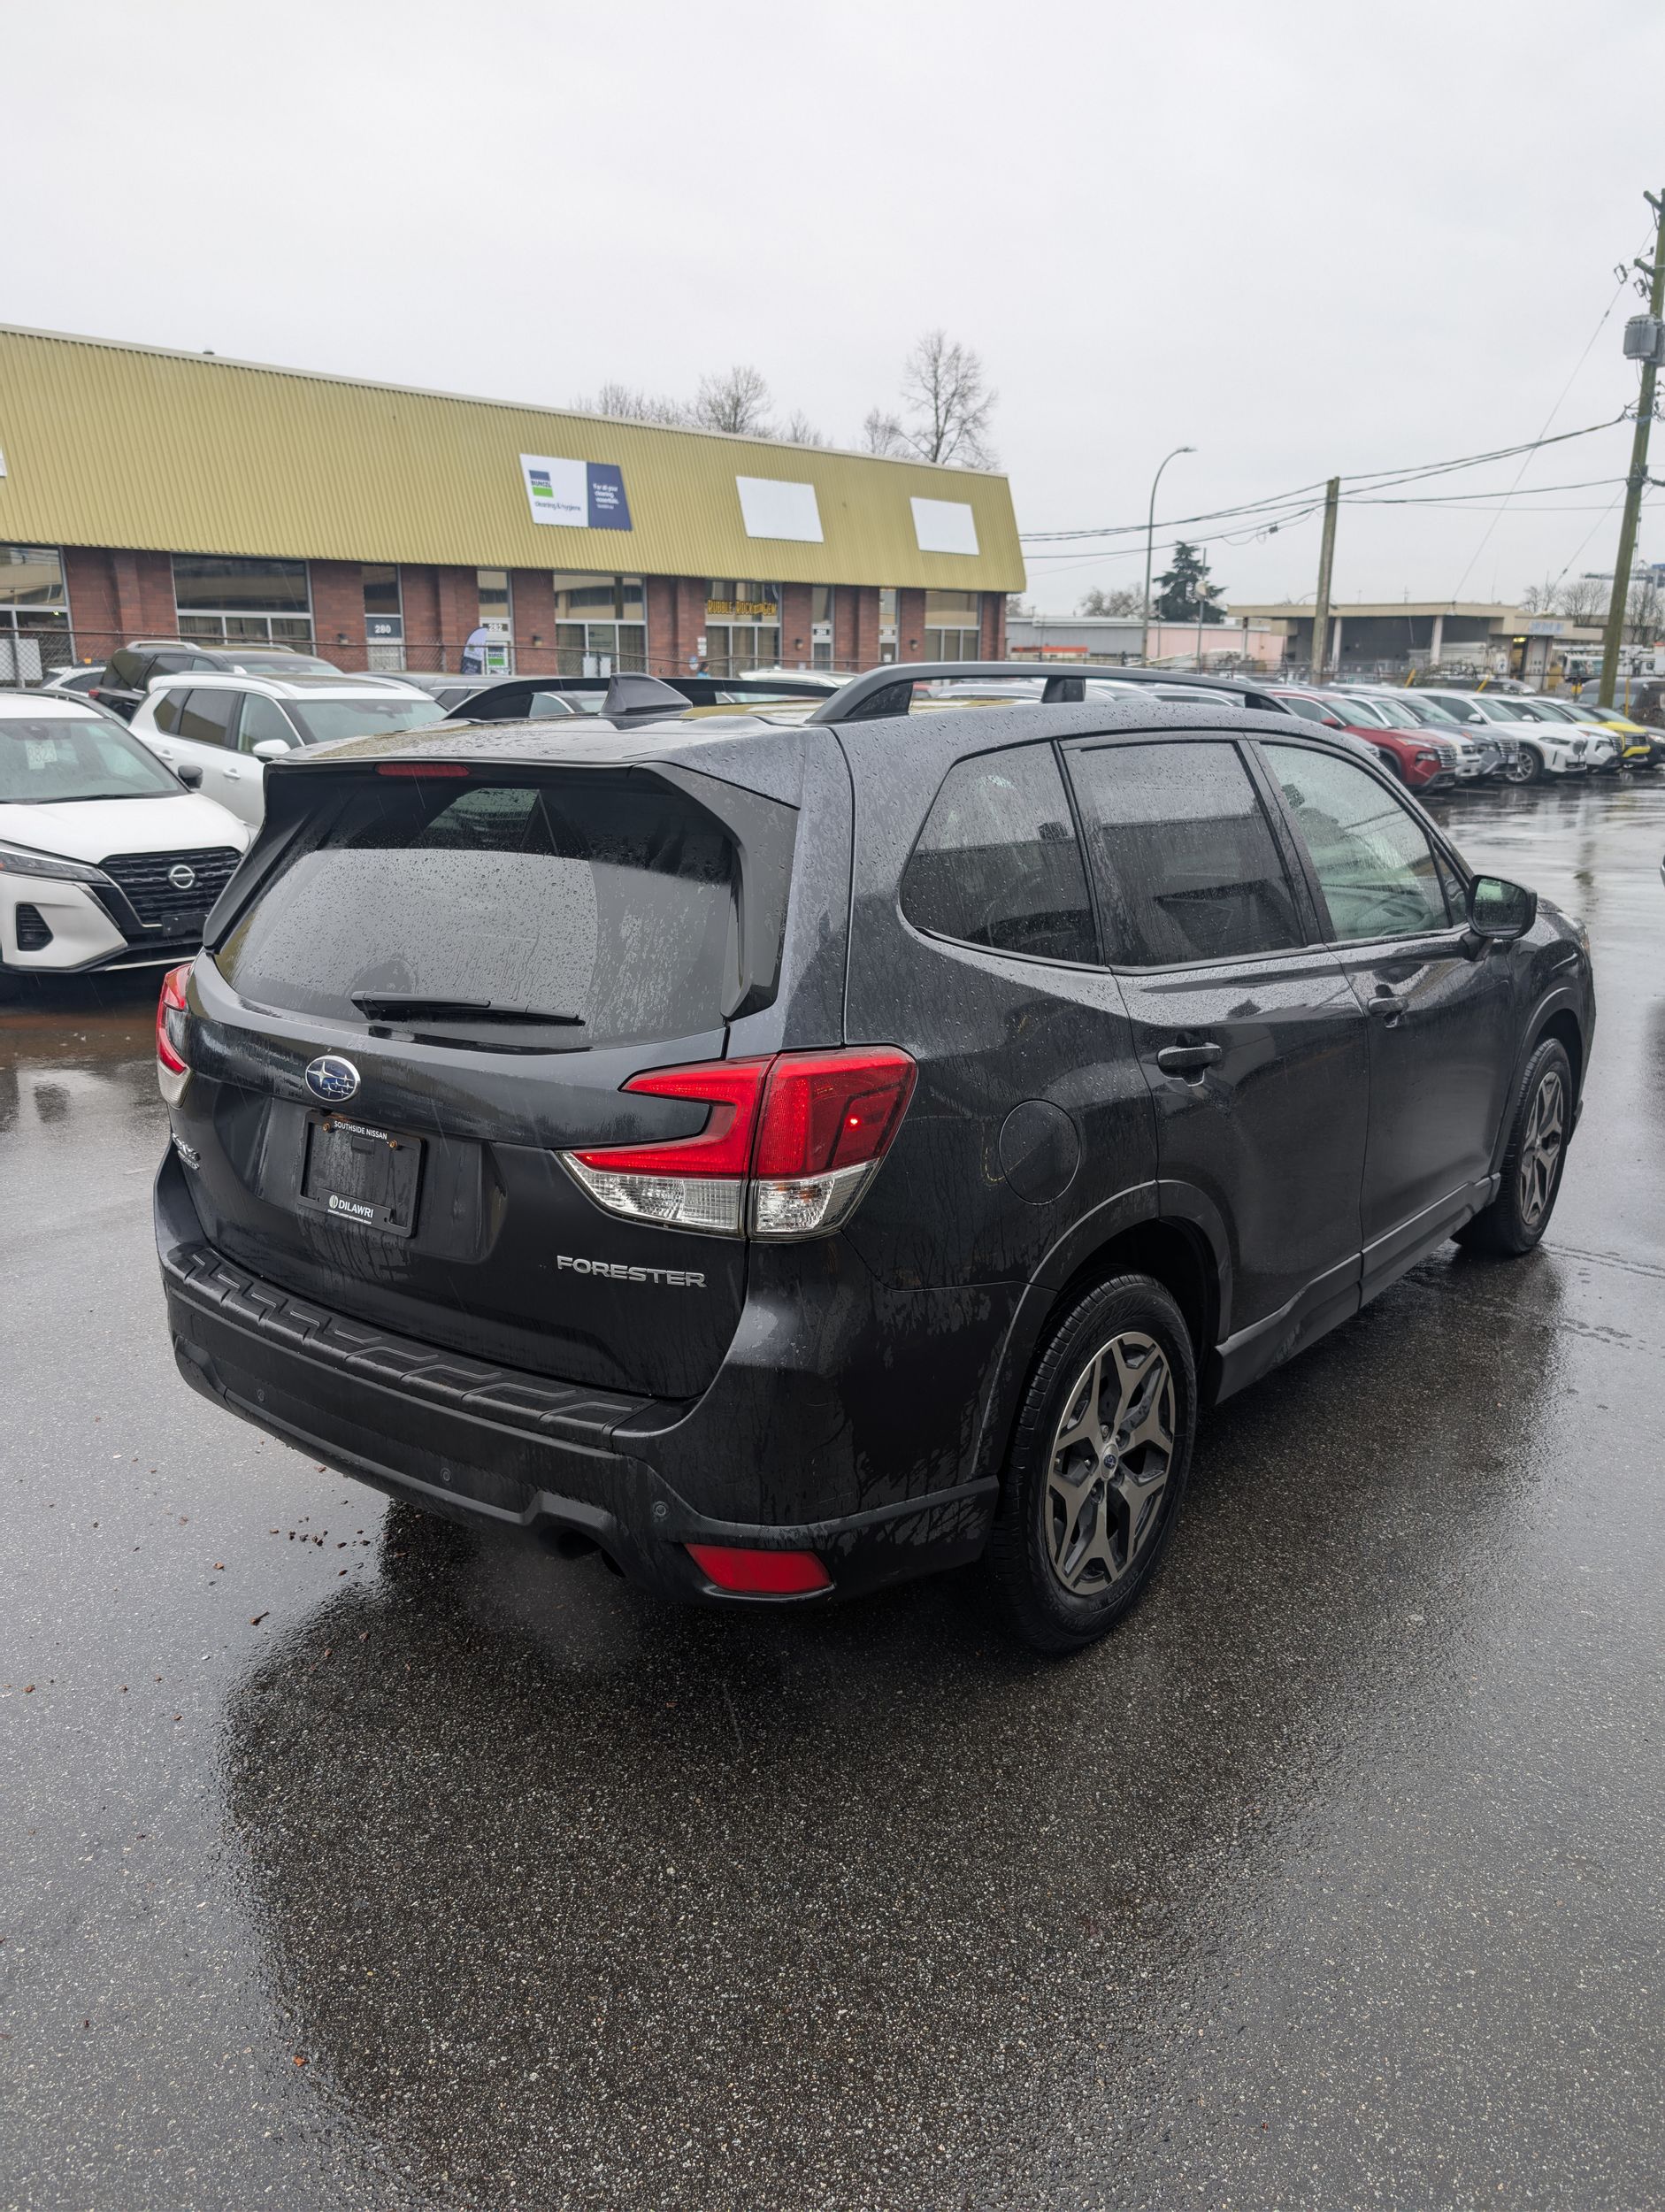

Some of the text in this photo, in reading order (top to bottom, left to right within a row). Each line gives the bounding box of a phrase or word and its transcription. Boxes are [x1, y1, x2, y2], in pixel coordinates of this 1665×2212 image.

[334, 1120, 387, 1141] SOUTHSIDE NISSAN
[338, 1199, 374, 1218] DILAWRI
[556, 1255, 707, 1288] FORESTER
